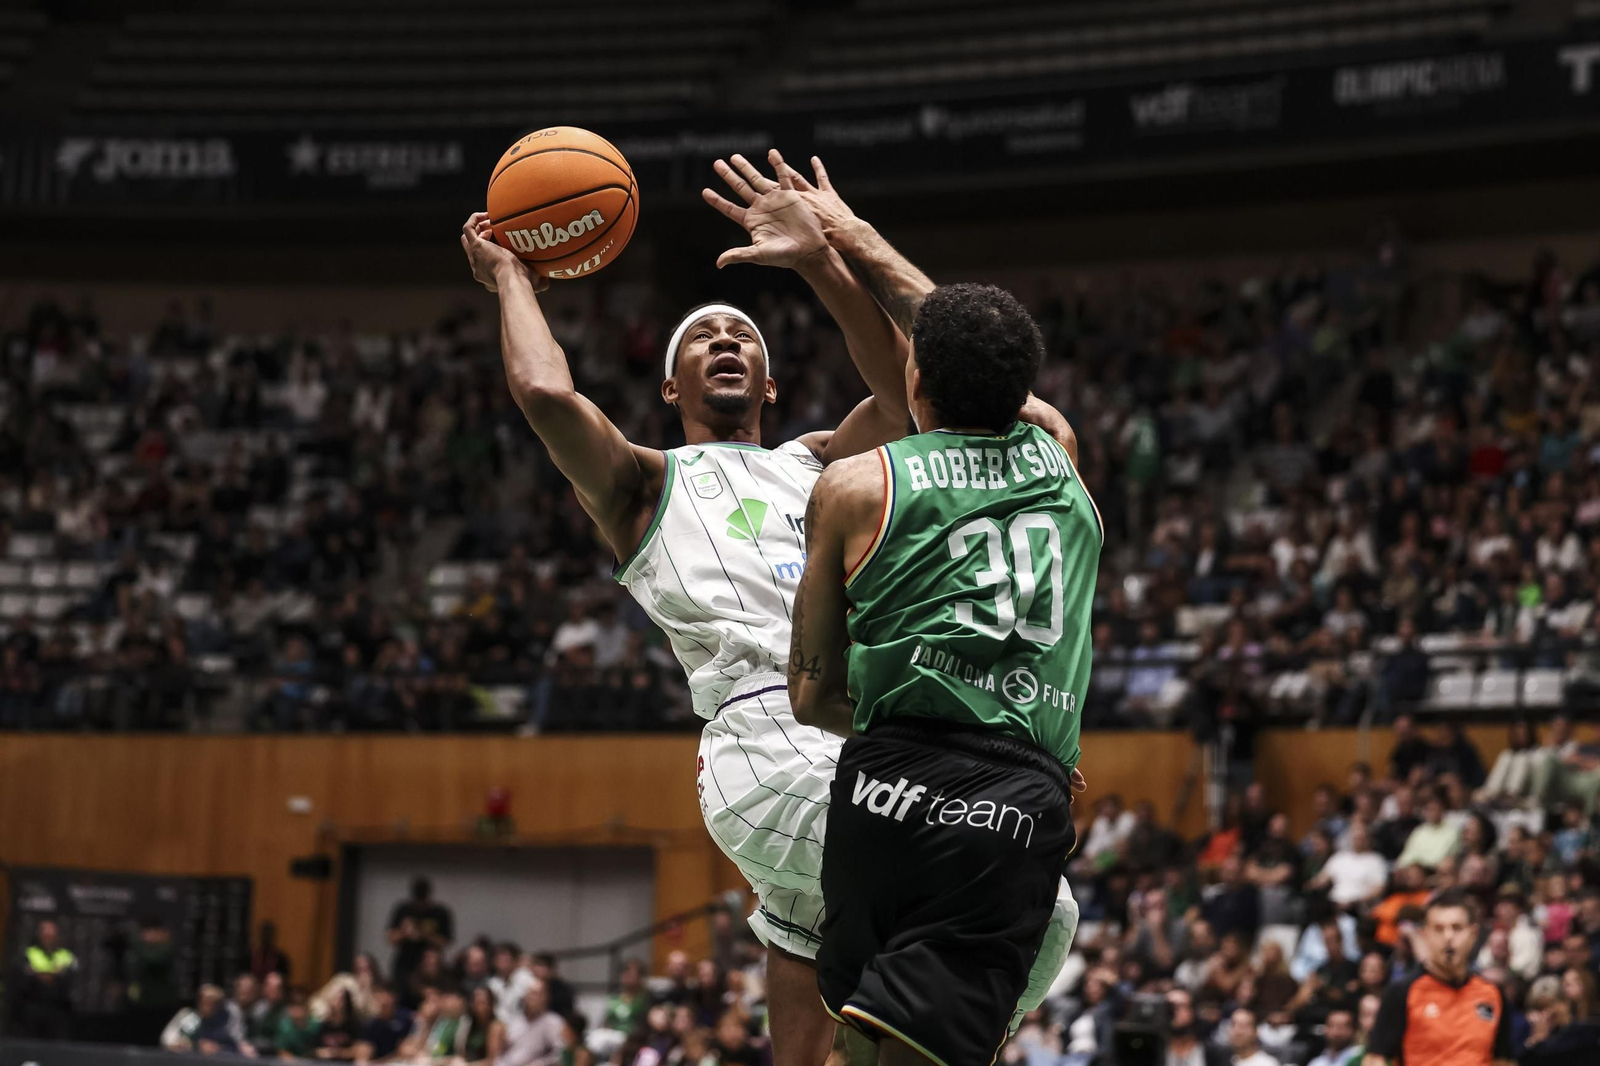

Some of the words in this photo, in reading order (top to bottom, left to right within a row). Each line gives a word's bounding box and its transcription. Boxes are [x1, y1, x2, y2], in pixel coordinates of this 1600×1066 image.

[505, 209, 605, 254] Wilson
[904, 438, 1072, 492] ROBERTSON
[947, 512, 1064, 647] 30
[910, 645, 996, 693] BADALONA
[851, 770, 928, 822] vdf
[925, 789, 1035, 849] team
